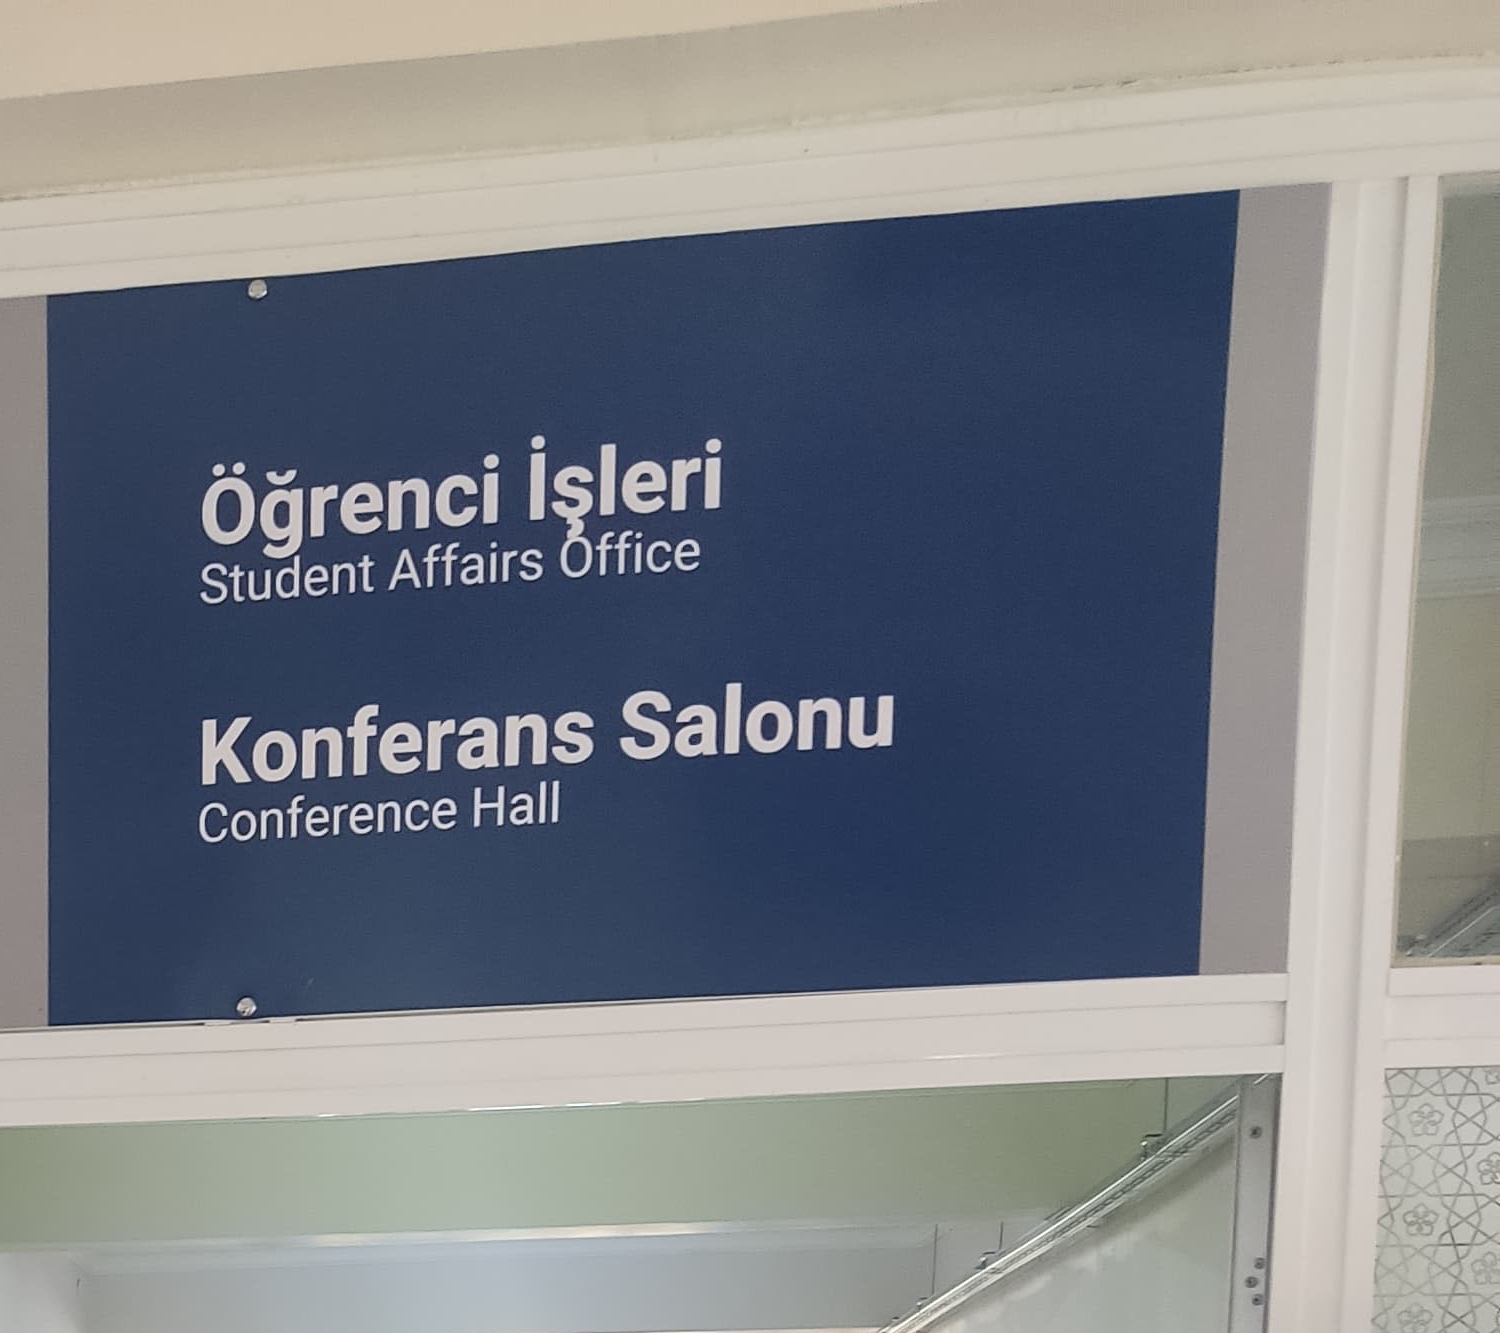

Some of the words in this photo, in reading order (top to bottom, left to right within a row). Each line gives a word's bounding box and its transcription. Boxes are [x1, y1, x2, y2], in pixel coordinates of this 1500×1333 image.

[201, 453, 501, 560] Öğrenci
[528, 435, 724, 540] İşleri
[199, 552, 376, 606] Student
[388, 539, 544, 592] Affairs
[559, 527, 701, 579] Office
[201, 703, 595, 786] Konferans
[619, 682, 896, 760] Salonu
[198, 794, 458, 843] Conference
[472, 781, 561, 829] Hall
